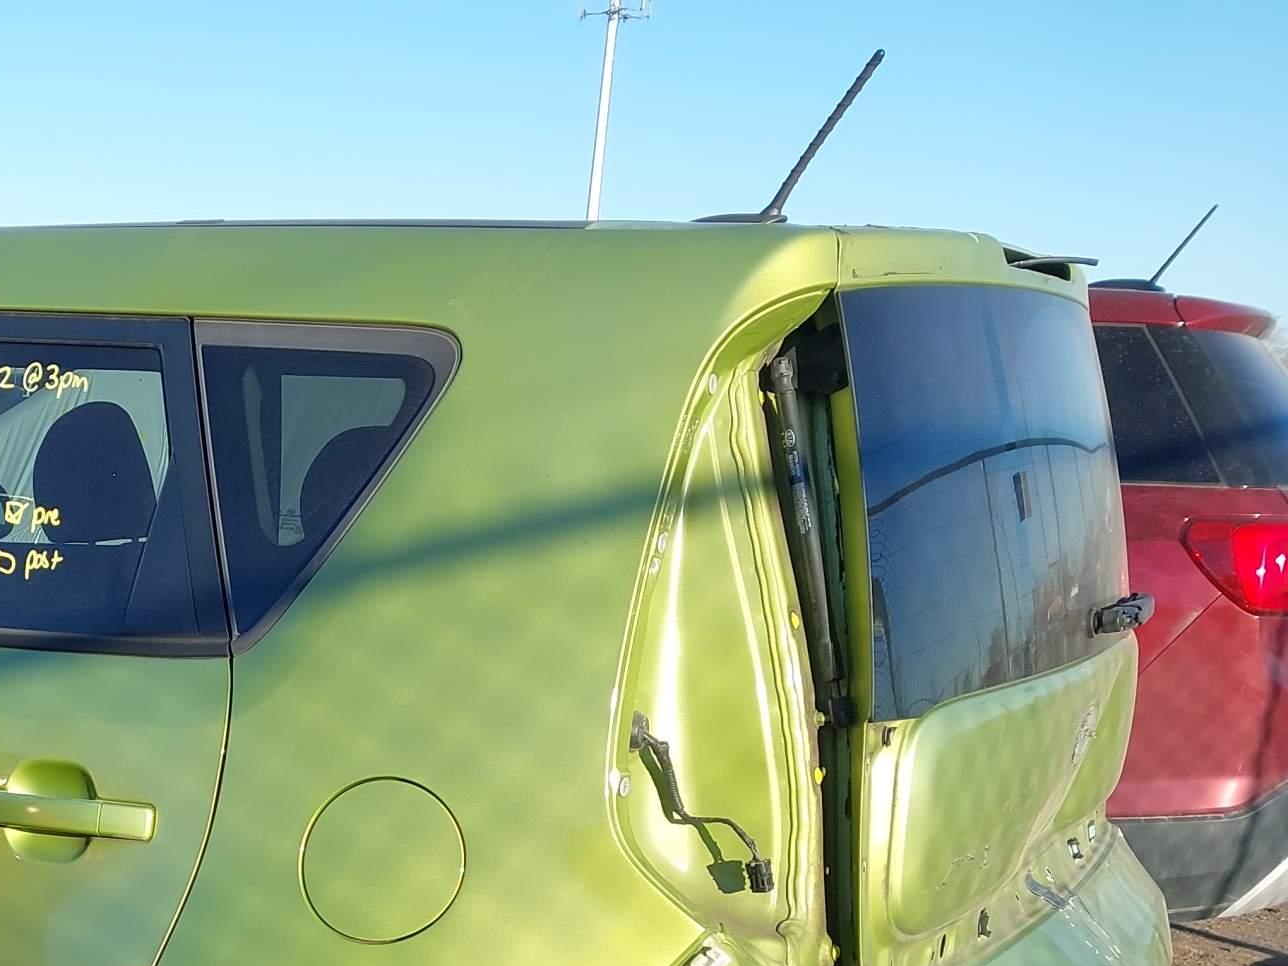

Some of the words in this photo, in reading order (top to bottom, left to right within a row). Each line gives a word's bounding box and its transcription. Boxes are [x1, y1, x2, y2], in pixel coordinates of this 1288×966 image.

[23, 362, 43, 393] @
[45, 364, 89, 399] 3pm
[31, 506, 61, 533] pre
[24, 549, 64, 581] post
